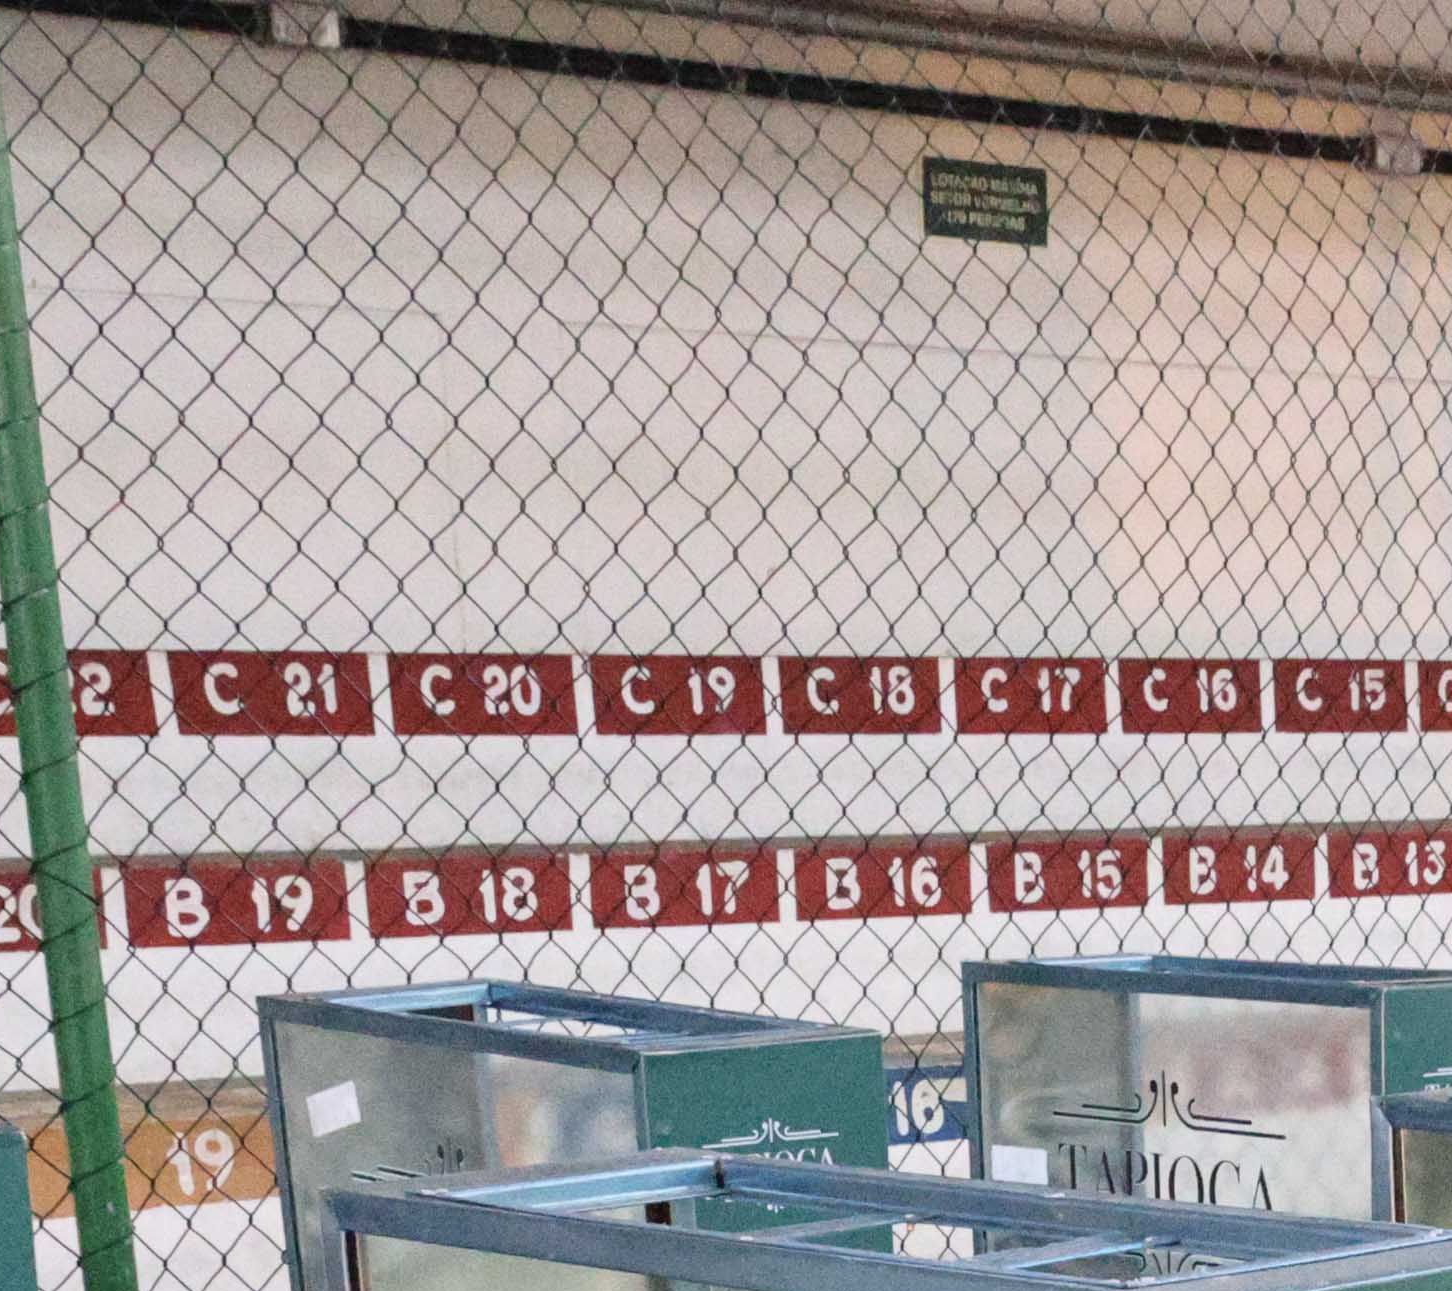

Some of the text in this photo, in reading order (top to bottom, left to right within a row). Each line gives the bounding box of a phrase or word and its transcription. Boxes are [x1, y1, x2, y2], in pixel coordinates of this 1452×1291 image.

[204, 662, 337, 716] C 21
[420, 664, 540, 715] C 20
[622, 666, 735, 714] C 19
[807, 666, 914, 714] C 18
[981, 668, 1080, 712] C 17
[1144, 668, 1236, 712] C 16
[1296, 668, 1386, 711] C 15
[624, 860, 749, 920] B 17
[826, 857, 941, 910] B 16
[1015, 850, 1121, 903] B 15
[1190, 846, 1288, 894] B 14
[1353, 841, 1445, 890] B 13
[165, 875, 313, 938] B 19
[403, 868, 537, 925] B 18
[166, 1128, 234, 1196] 19
